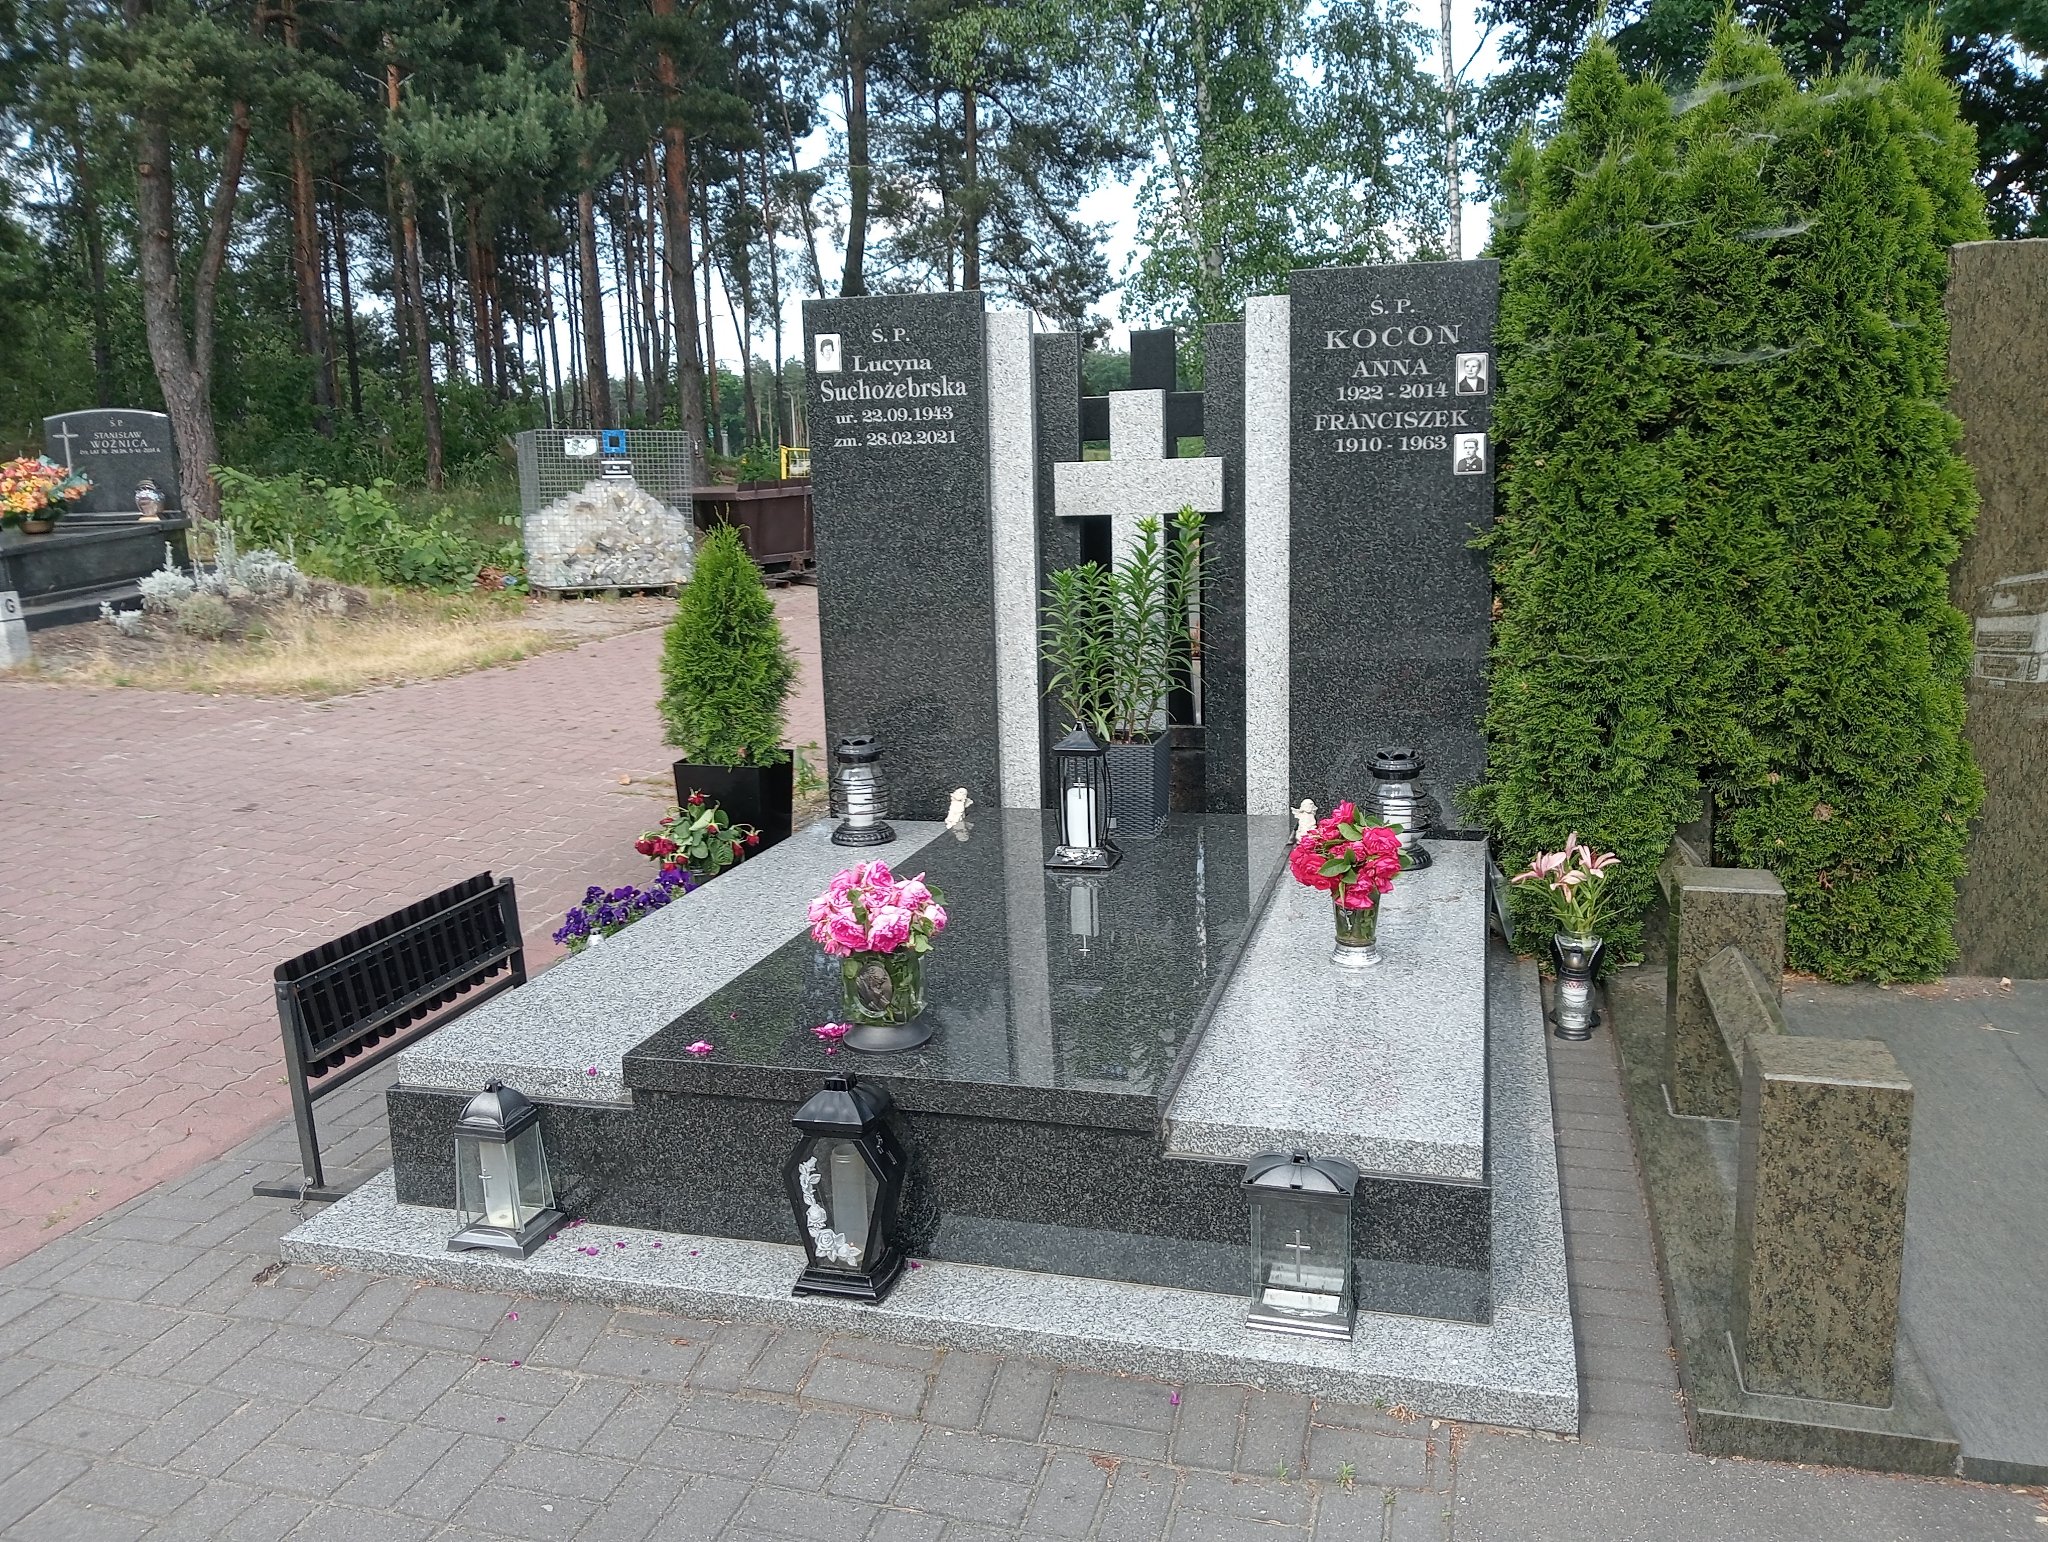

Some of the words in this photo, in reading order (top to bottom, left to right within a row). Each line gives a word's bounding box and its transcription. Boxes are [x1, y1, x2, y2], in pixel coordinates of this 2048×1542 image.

[1323, 324, 1463, 350] KOCON
[852, 355, 933, 376] Lucyna
[1351, 357, 1432, 378] ANNA
[820, 375, 968, 403] Suchożebrska
[1336, 385, 1383, 402] 1922
[1399, 381, 1449, 399] 2014
[835, 414, 858, 425] ur.
[862, 405, 954, 423] 22.09.1943
[1313, 409, 1469, 431] FRANCISZEK
[93, 431, 143, 440] STANISŁAW
[834, 436, 863, 448] zm.
[866, 430, 958, 446] 28.02.2021
[1335, 436, 1382, 453] 1910
[1399, 434, 1448, 451] 1963
